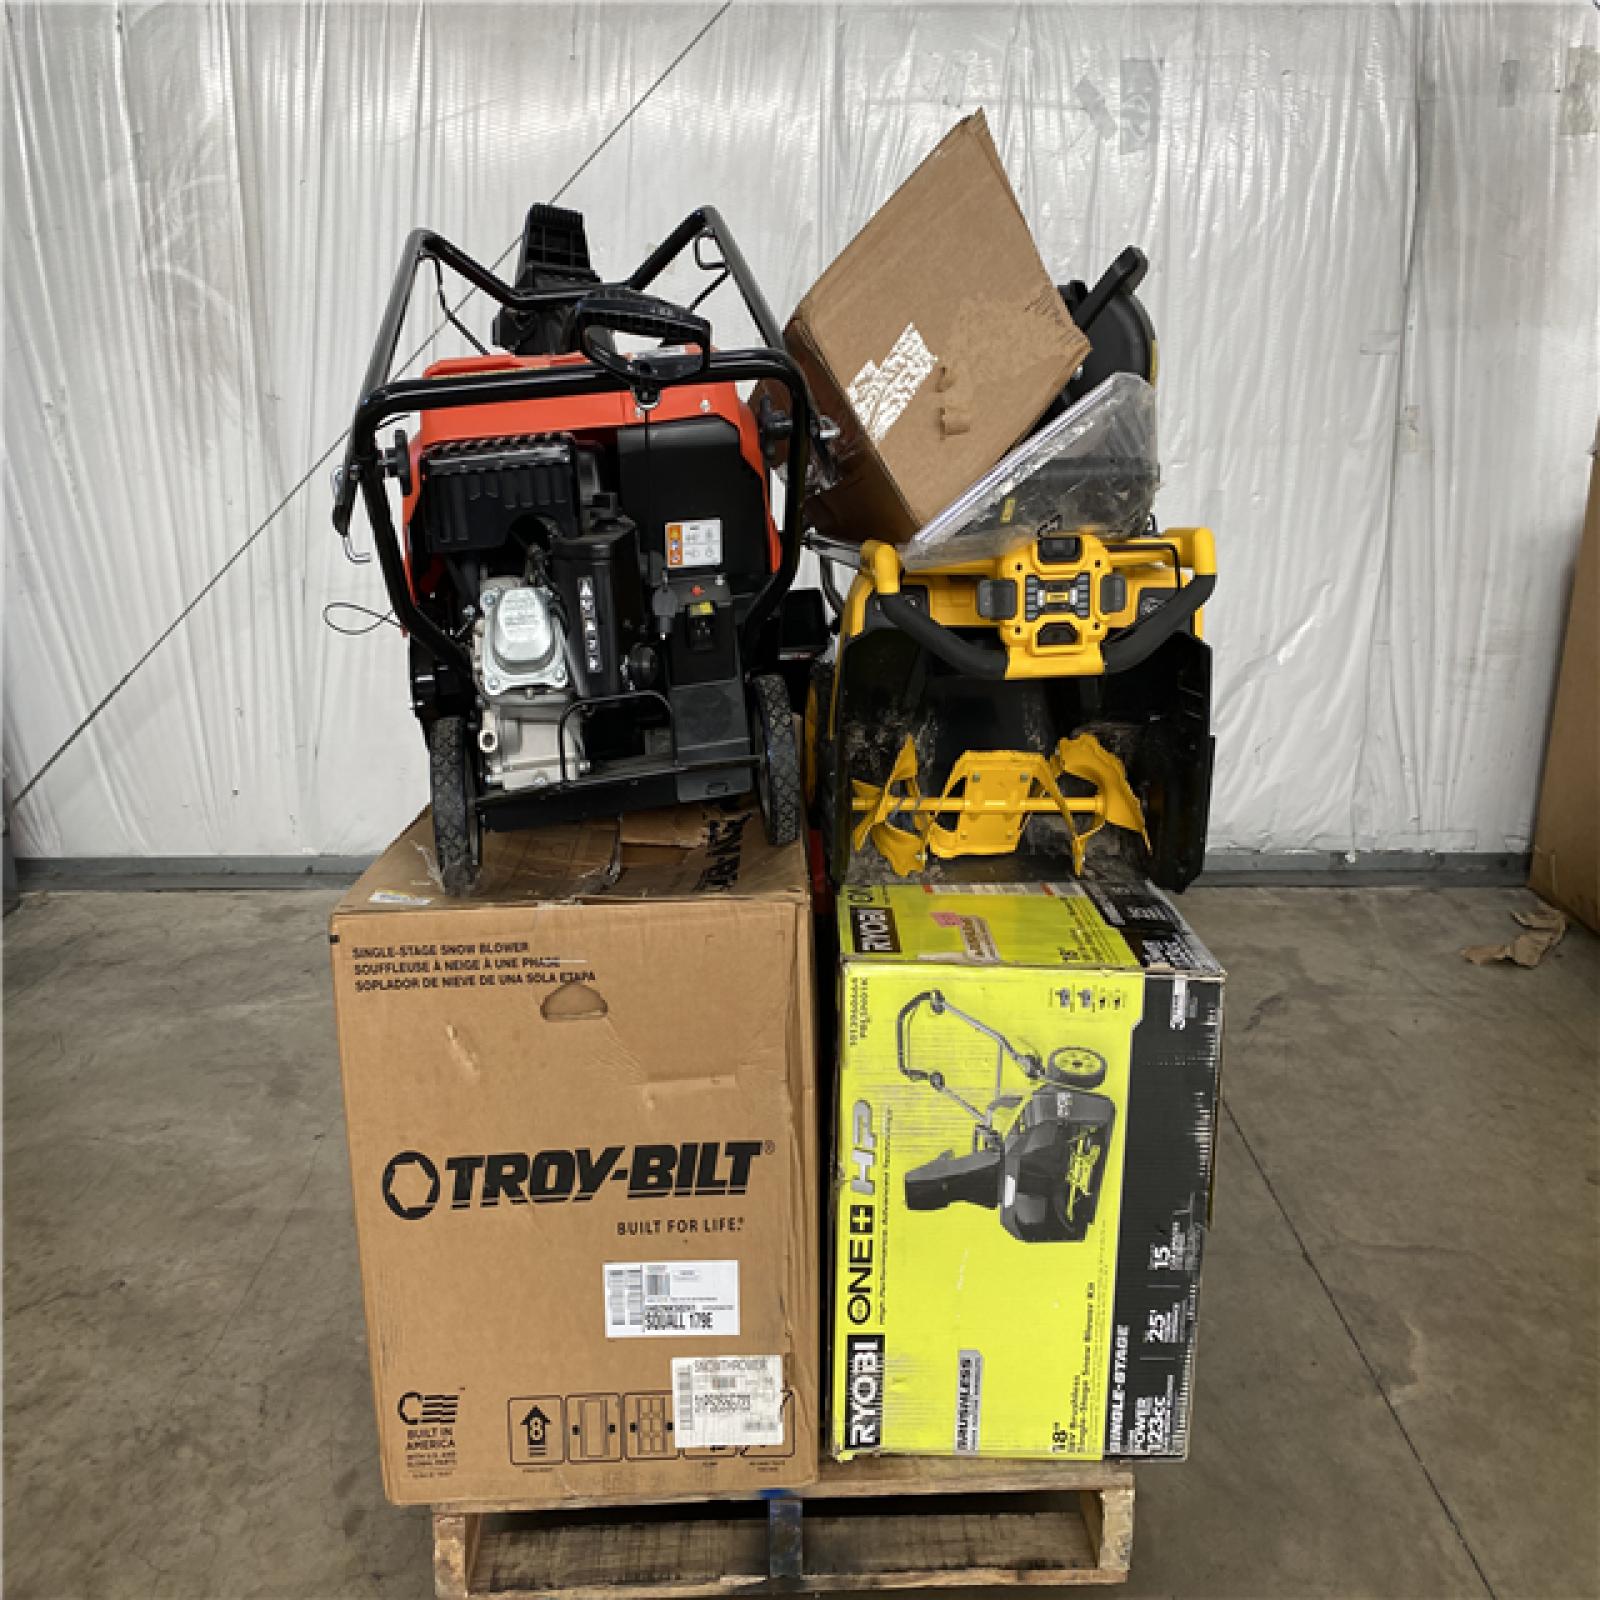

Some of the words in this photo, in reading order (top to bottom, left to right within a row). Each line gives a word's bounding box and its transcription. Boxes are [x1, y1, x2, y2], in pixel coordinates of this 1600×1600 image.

[858, 909, 895, 953] RYOBI
[352, 945, 437, 958] SINGLE-STAGE
[440, 944, 476, 956] SNOW
[479, 942, 529, 954] BLOWER
[354, 961, 430, 975] SOUFFLEUSE
[444, 959, 481, 971] NEIGE
[494, 957, 518, 969] UNE
[354, 978, 420, 992] SOPLADOR
[422, 977, 439, 989] DE
[442, 975, 476, 988] NIEVE
[479, 974, 496, 986] DE
[499, 973, 523, 985] UNA
[526, 972, 556, 984] SOLA
[559, 971, 596, 982] ETAPA
[445, 1141, 763, 1210] TROY-BILT
[616, 1220, 662, 1236] BUILT
[666, 1219, 699, 1234] FOR
[1154, 1246, 1171, 1269] 15
[849, 1339, 882, 1447] RYOBI
[1109, 1324, 1129, 1453] SINGLE-STAGE
[407, 1427, 438, 1439] BUILT
[406, 1439, 456, 1450] AMERICA
